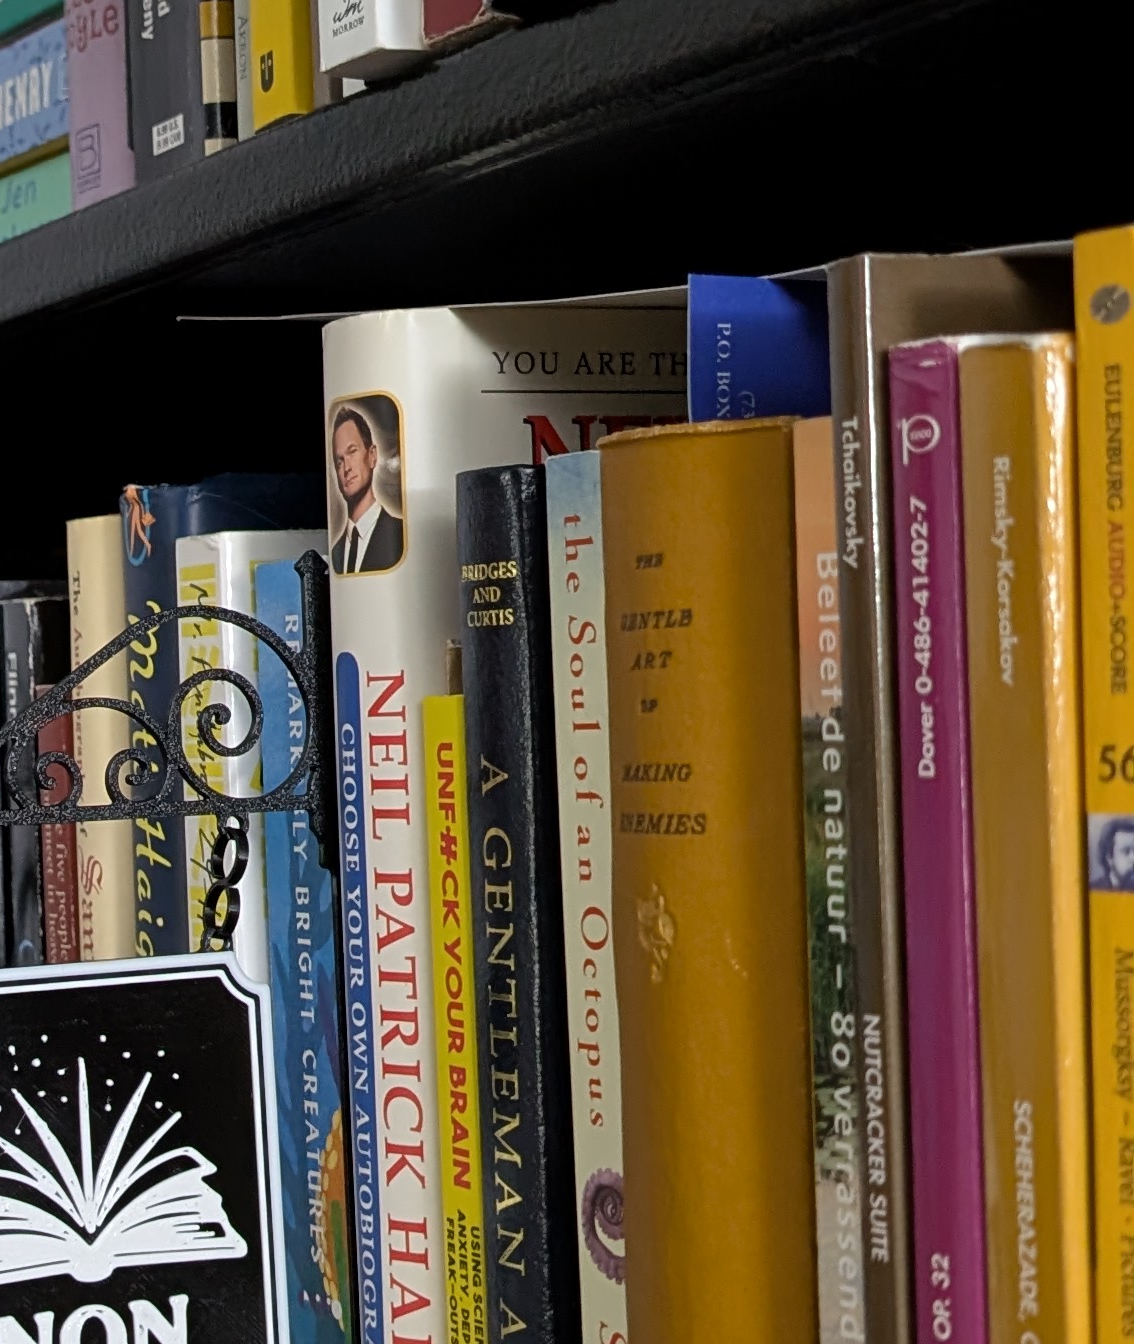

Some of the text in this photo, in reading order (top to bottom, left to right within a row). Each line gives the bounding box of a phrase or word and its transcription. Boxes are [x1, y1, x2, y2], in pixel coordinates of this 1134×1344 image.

[332, 15, 365, 38] MORROW
[1, 180, 37, 214] Jen
[492, 351, 635, 375] YOU ARE
[716, 322, 731, 418] P.O. BOX
[839, 416, 860, 569] Tchaikovsky
[1103, 363, 1128, 696] EULENBURG AUDIO+SCORE
[461, 560, 517, 582] BRIDGES
[467, 609, 514, 628] CURTIS
[472, 586, 500, 605] AND
[991, 456, 1018, 686] Rimsky-Korsakov
[620, 608, 693, 634] GENTLE
[631, 649, 672, 673] ART
[817, 552, 843, 704] Beleef
[910, 496, 936, 778] Dover 0-486-41402-7
[366, 668, 410, 841] NEIL
[480, 756, 509, 797] A
[621, 762, 693, 785] MAKING
[822, 715, 845, 774] de
[342, 721, 359, 873] CHOOSE
[563, 514, 610, 1129] the Soul of an Octopus
[619, 813, 707, 836] ENEMIES
[824, 789, 847, 943] natuur
[345, 885, 364, 990] YOUR
[295, 886, 323, 1264] BRIGHT CREATURES
[352, 1001, 370, 1092] OWN
[373, 868, 426, 1190] PATRICK
[444, 937, 472, 1190] YOUR BRAIN
[483, 832, 525, 1275] GENTLEMAN
[863, 1014, 889, 1263] NUTCRACKER SUITE
[457, 1209, 468, 1304] ANXIETY,
[470, 1226, 480, 1286] USING
[932, 1253, 951, 1290] 32
